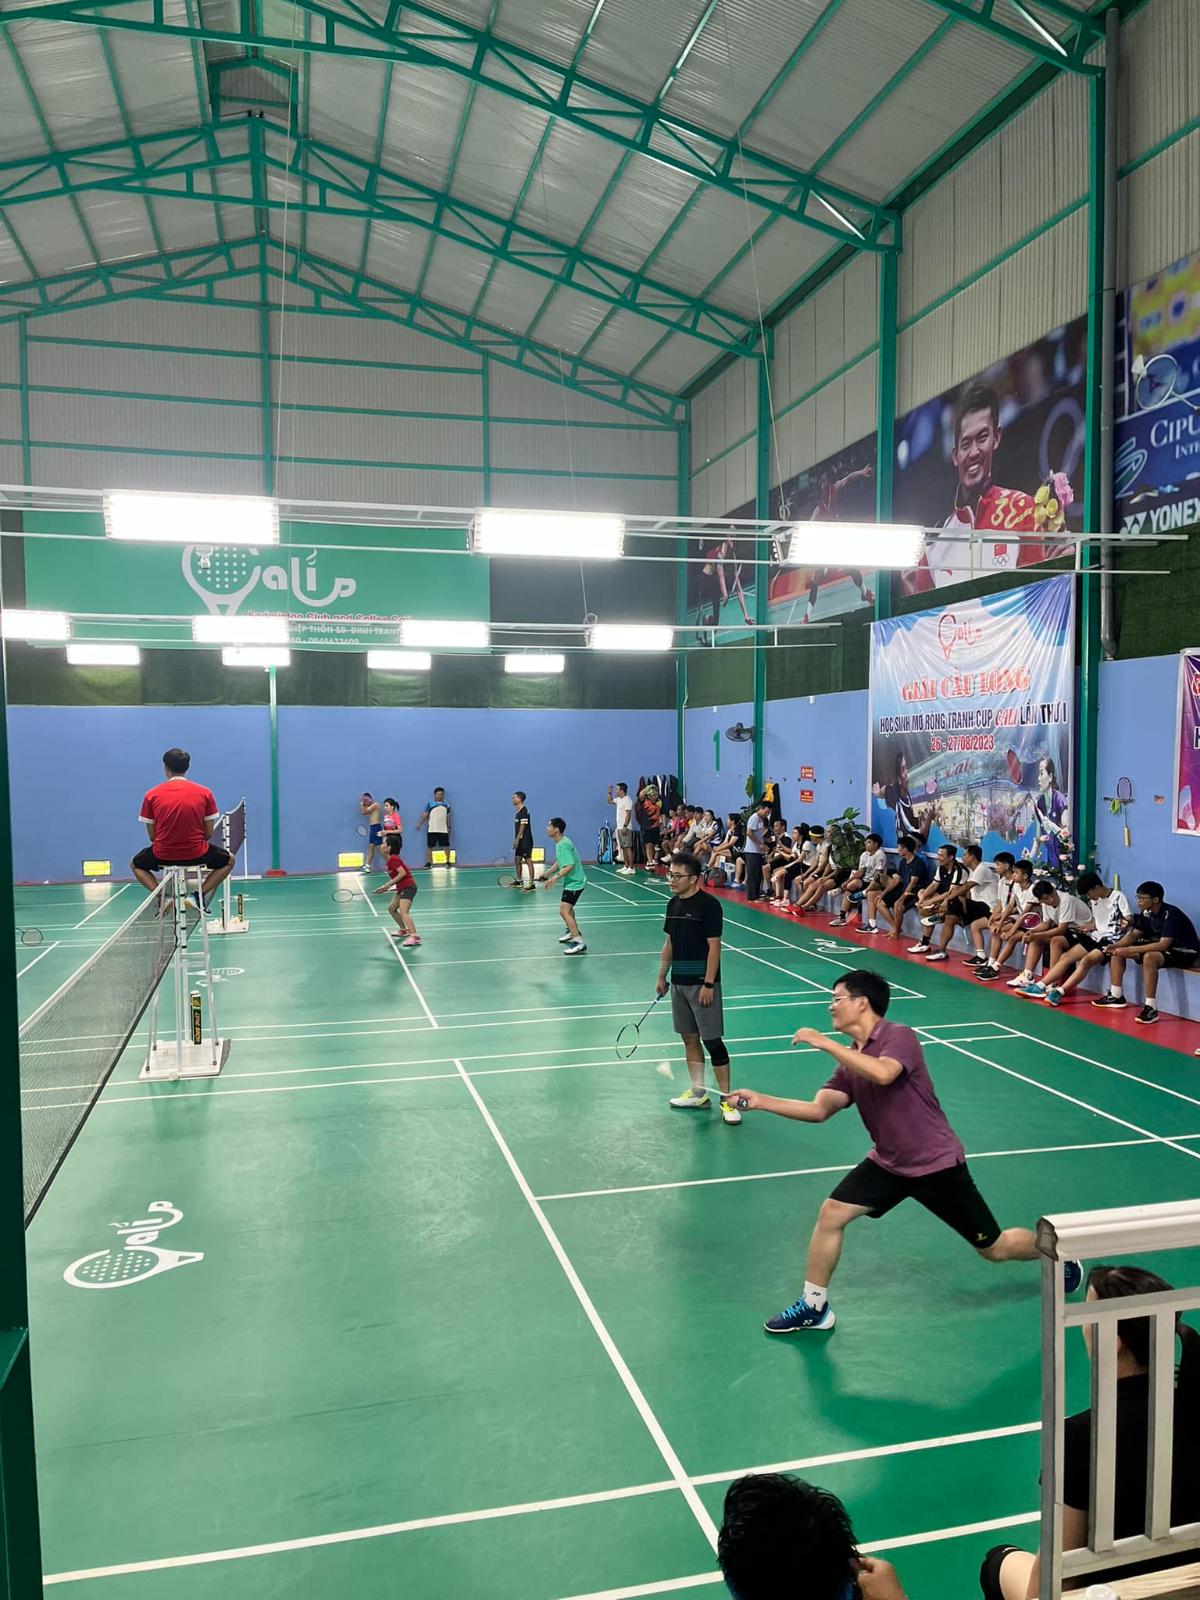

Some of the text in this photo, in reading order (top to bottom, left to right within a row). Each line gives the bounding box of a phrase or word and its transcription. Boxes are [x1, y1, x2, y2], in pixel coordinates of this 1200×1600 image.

[947, 711, 974, 730] TRANH
[976, 709, 993, 728] CUP
[930, 736, 942, 751] 26
[948, 734, 994, 751] 27/08/2023
